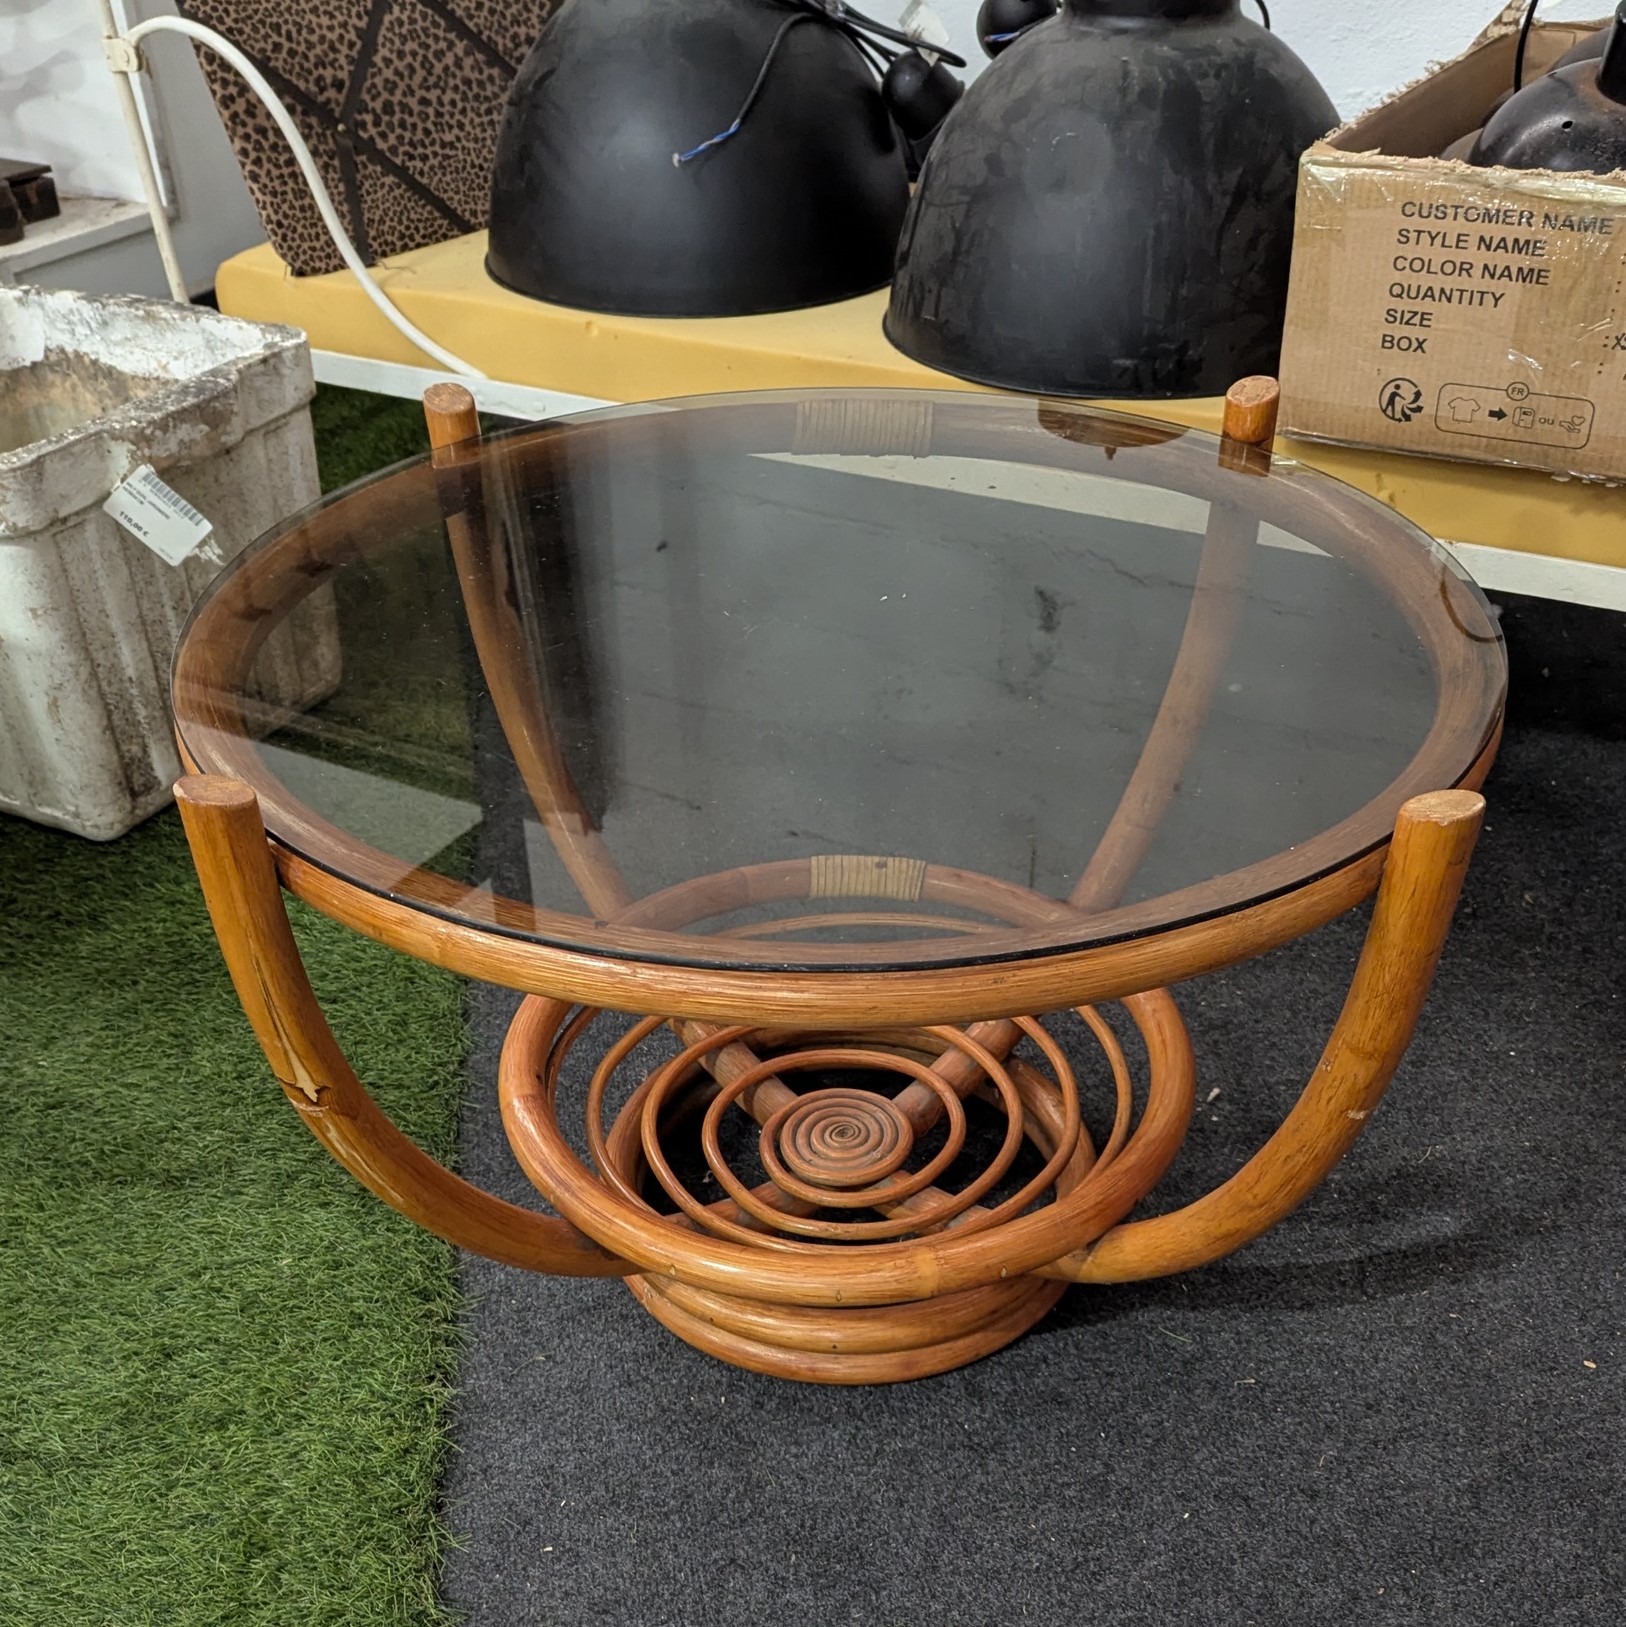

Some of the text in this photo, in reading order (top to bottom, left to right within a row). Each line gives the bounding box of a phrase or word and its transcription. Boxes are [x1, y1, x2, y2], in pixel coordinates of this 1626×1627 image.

[1401, 201, 1615, 236] CUSTOMER NAME
[1397, 228, 1549, 258] STYLE NAME
[1392, 255, 1552, 286] COLOR NAME
[1388, 282, 1506, 309] QUANTITY
[1384, 308, 1434, 329] SIZE
[1381, 334, 1428, 354] BOX
[1511, 386, 1525, 397] FR
[119, 511, 143, 532] 110,00
